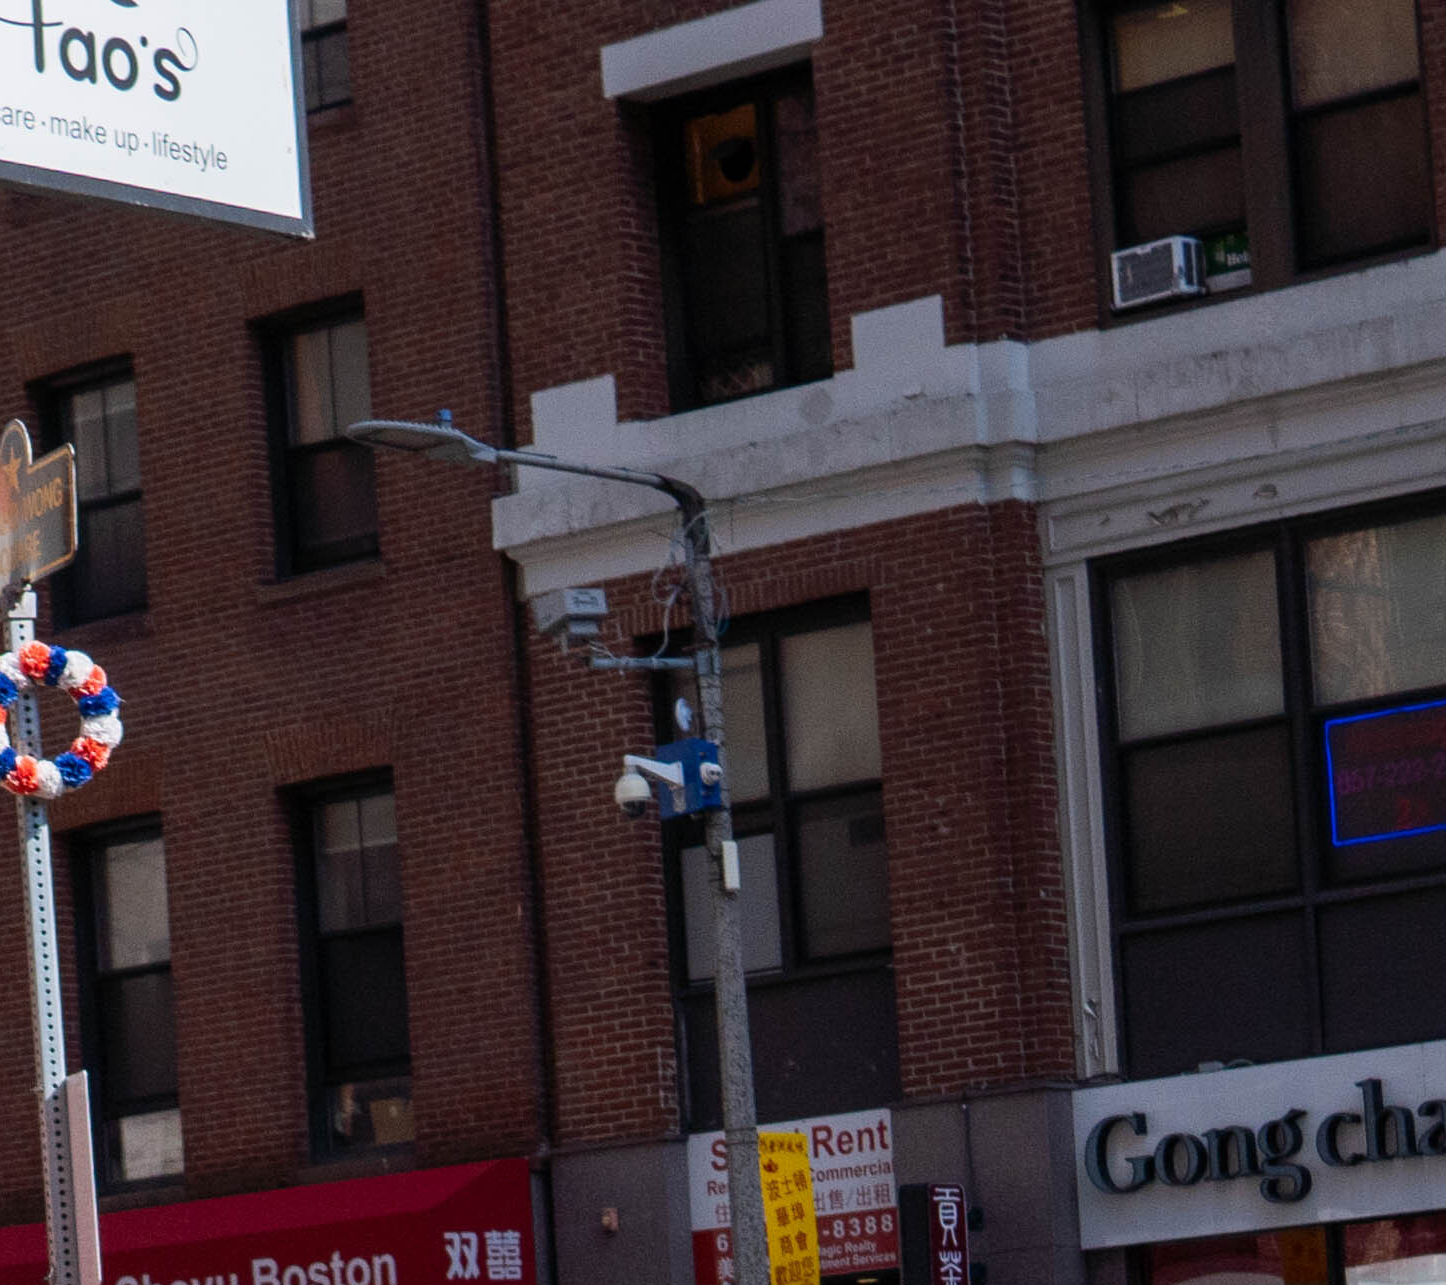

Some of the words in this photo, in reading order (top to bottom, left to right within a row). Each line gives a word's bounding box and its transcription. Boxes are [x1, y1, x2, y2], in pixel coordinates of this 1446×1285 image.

[50, 115, 108, 146] make
[114, 126, 140, 157] up
[152, 130, 228, 171] lifestyle
[811, 1119, 891, 1159] Rent
[1084, 1105, 1313, 1203] Gong
